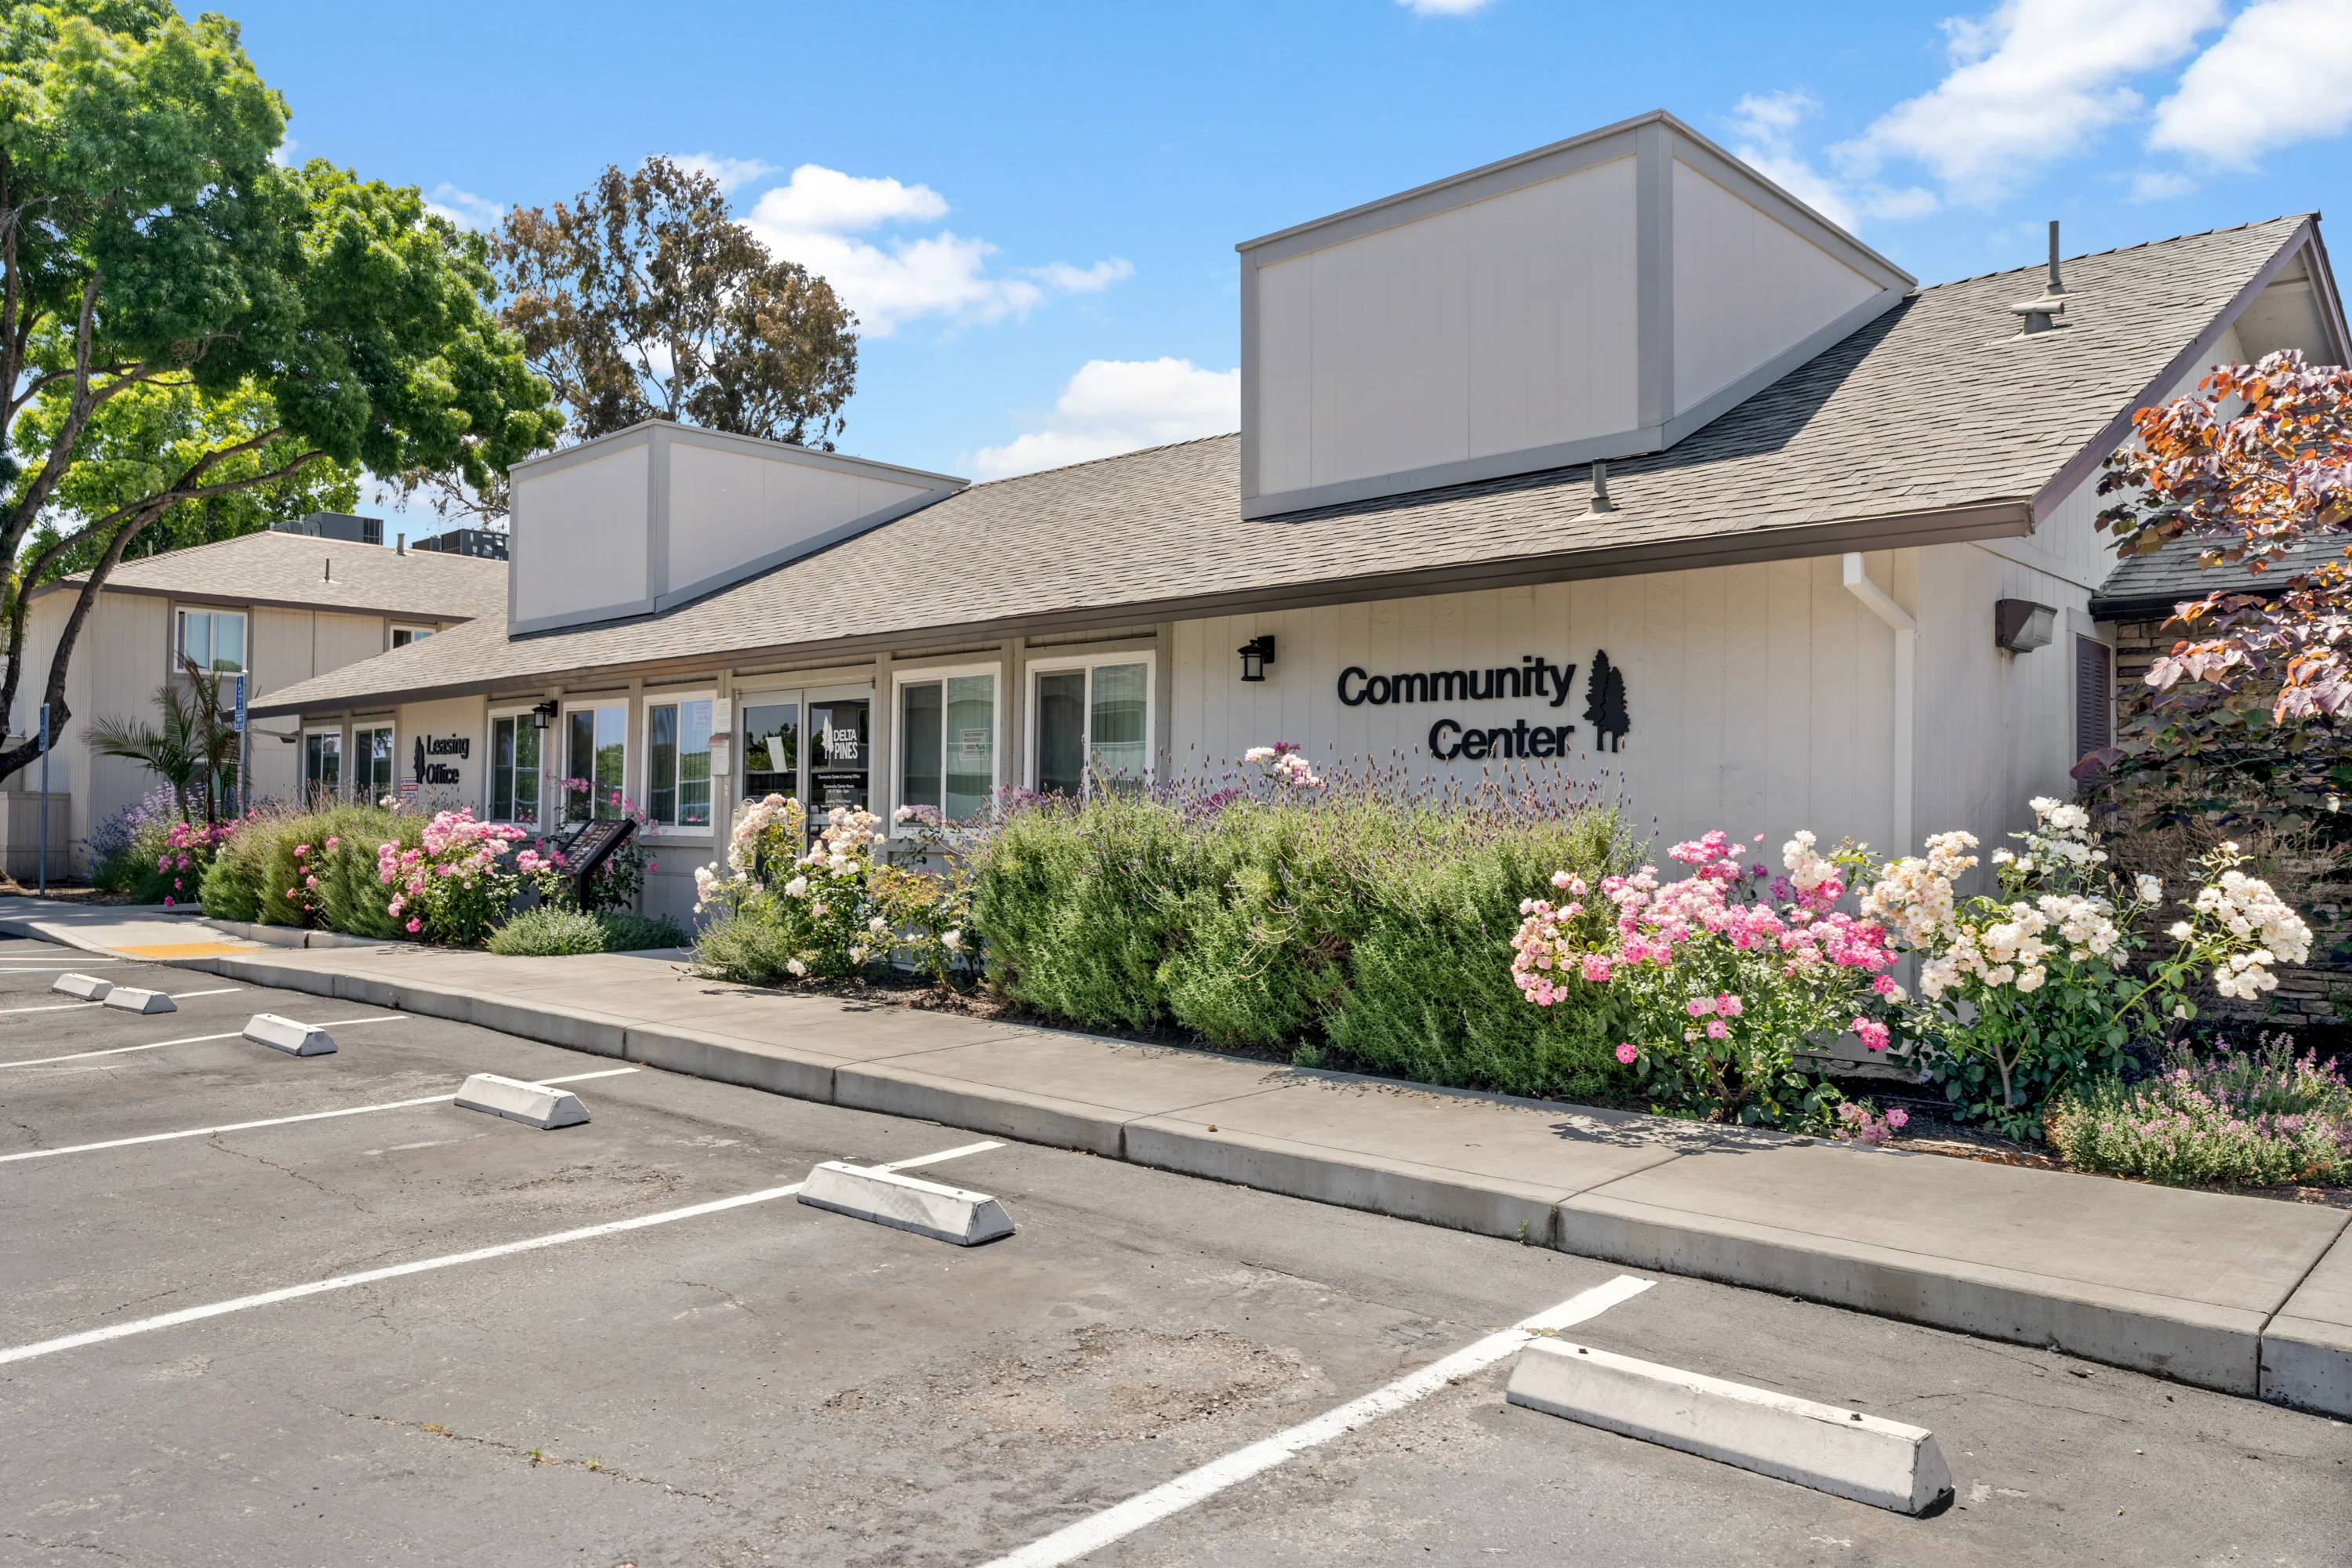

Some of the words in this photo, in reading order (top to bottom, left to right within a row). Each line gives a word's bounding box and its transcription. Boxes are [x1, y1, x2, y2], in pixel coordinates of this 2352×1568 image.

[1338, 655, 1577, 707] Community
[426, 733, 470, 759] Leasing
[833, 729, 858, 742] DELTA
[1428, 719, 1575, 760] Center
[834, 742, 858, 760] PINES
[426, 763, 459, 785] Office
